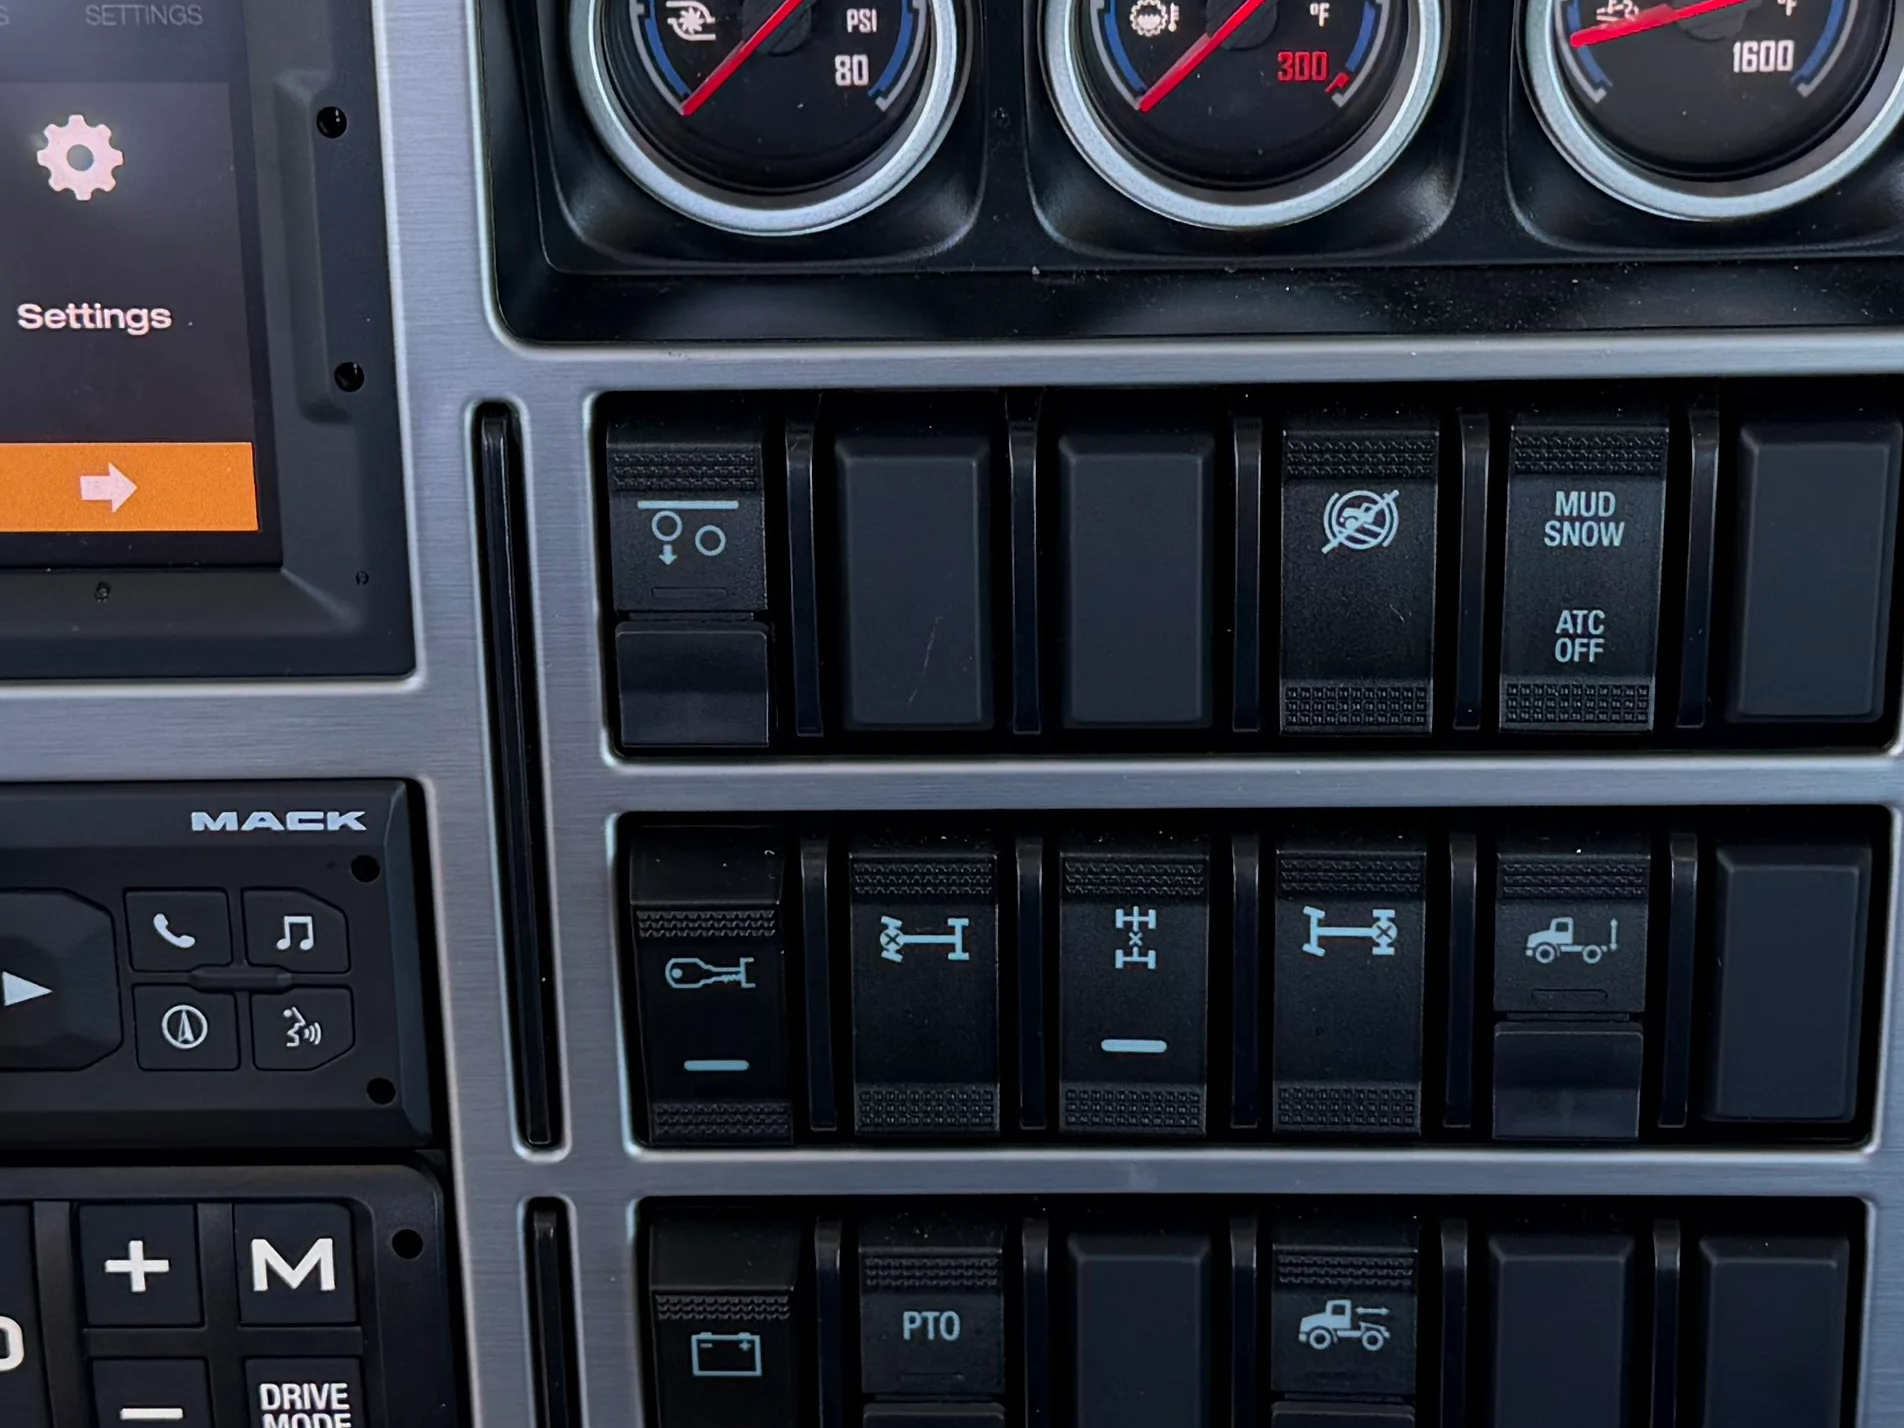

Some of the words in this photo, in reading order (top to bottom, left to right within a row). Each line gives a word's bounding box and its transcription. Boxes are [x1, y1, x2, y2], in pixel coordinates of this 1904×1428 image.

[84, 3, 204, 27] SETTINGS
[846, 8, 878, 34] PSI
[834, 54, 869, 87] 80
[1277, 51, 1329, 82] 300
[1732, 40, 1795, 73] 1600
[17, 303, 172, 336] Settings
[1555, 491, 1616, 517] MUD
[1544, 520, 1625, 547] SNOW
[1555, 610, 1605, 635] ATC
[1554, 637, 1605, 663] OFF
[191, 811, 367, 831] MACK
[251, 1238, 336, 1291] M
[903, 1311, 960, 1341] PTO
[259, 1382, 350, 1411] DRIVE
